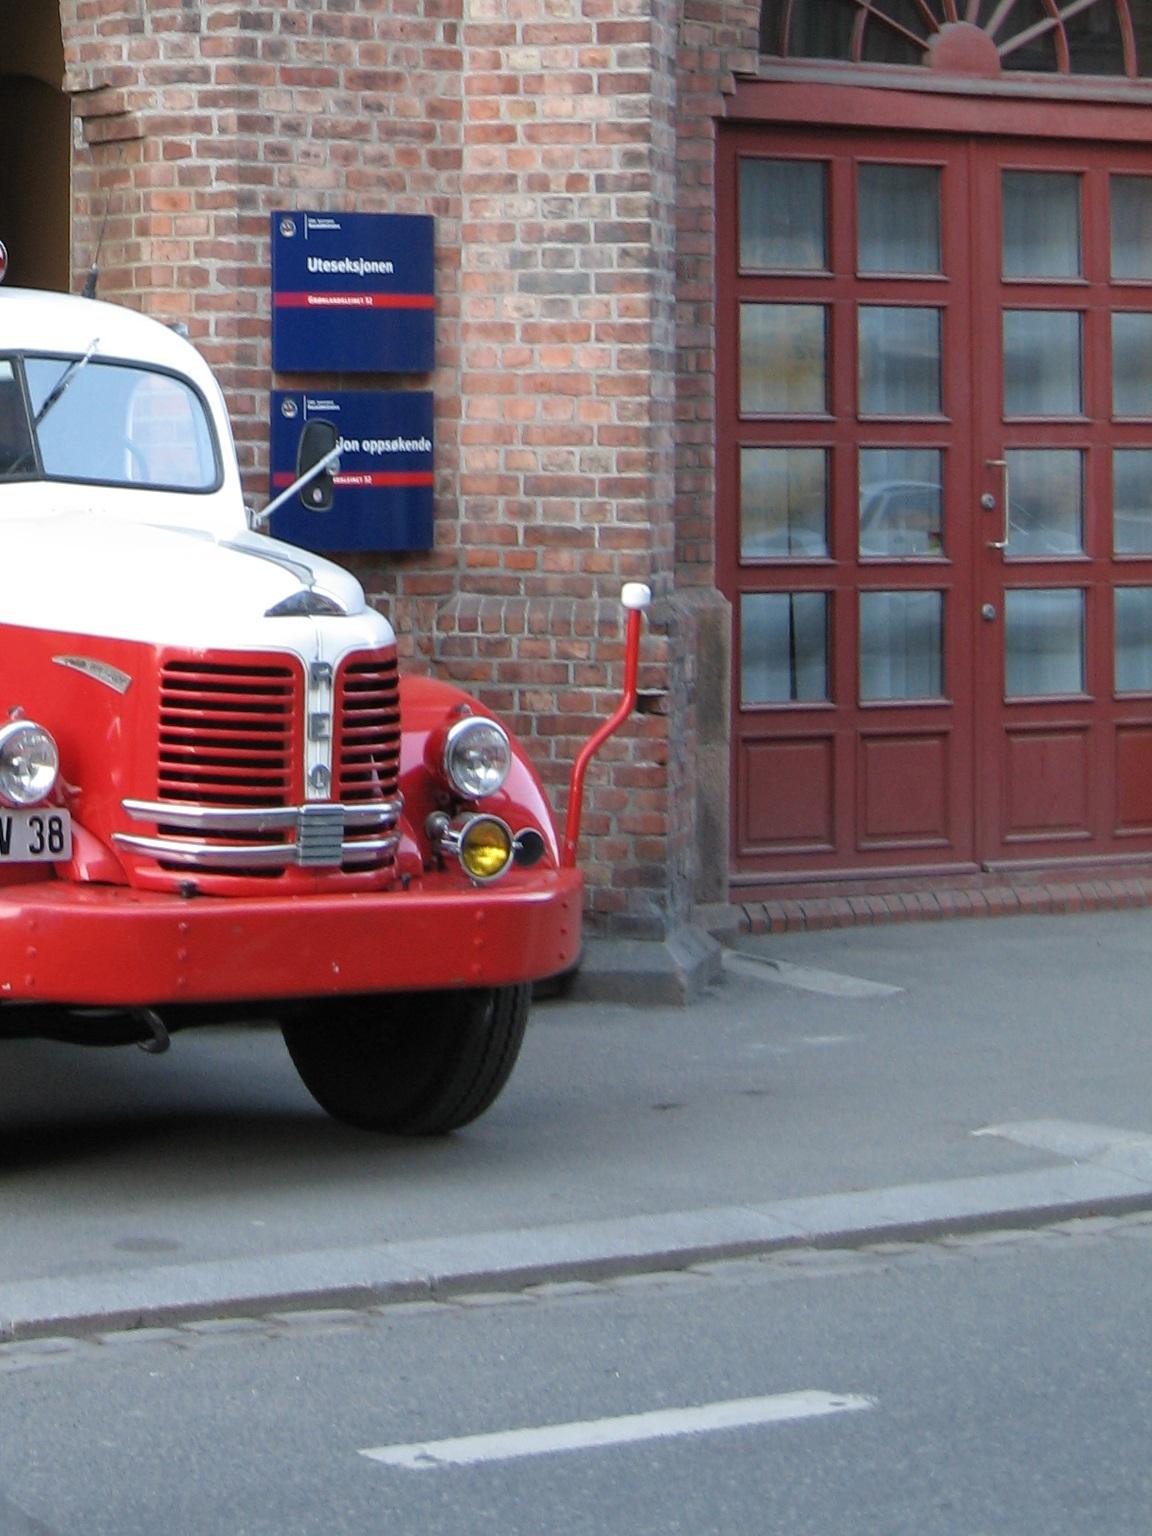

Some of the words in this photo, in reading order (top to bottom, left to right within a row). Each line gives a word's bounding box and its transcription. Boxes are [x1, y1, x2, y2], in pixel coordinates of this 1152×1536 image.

[307, 256, 394, 277] Uteseksjonen
[362, 436, 432, 455] oppsøkende
[28, 814, 65, 855] 38
